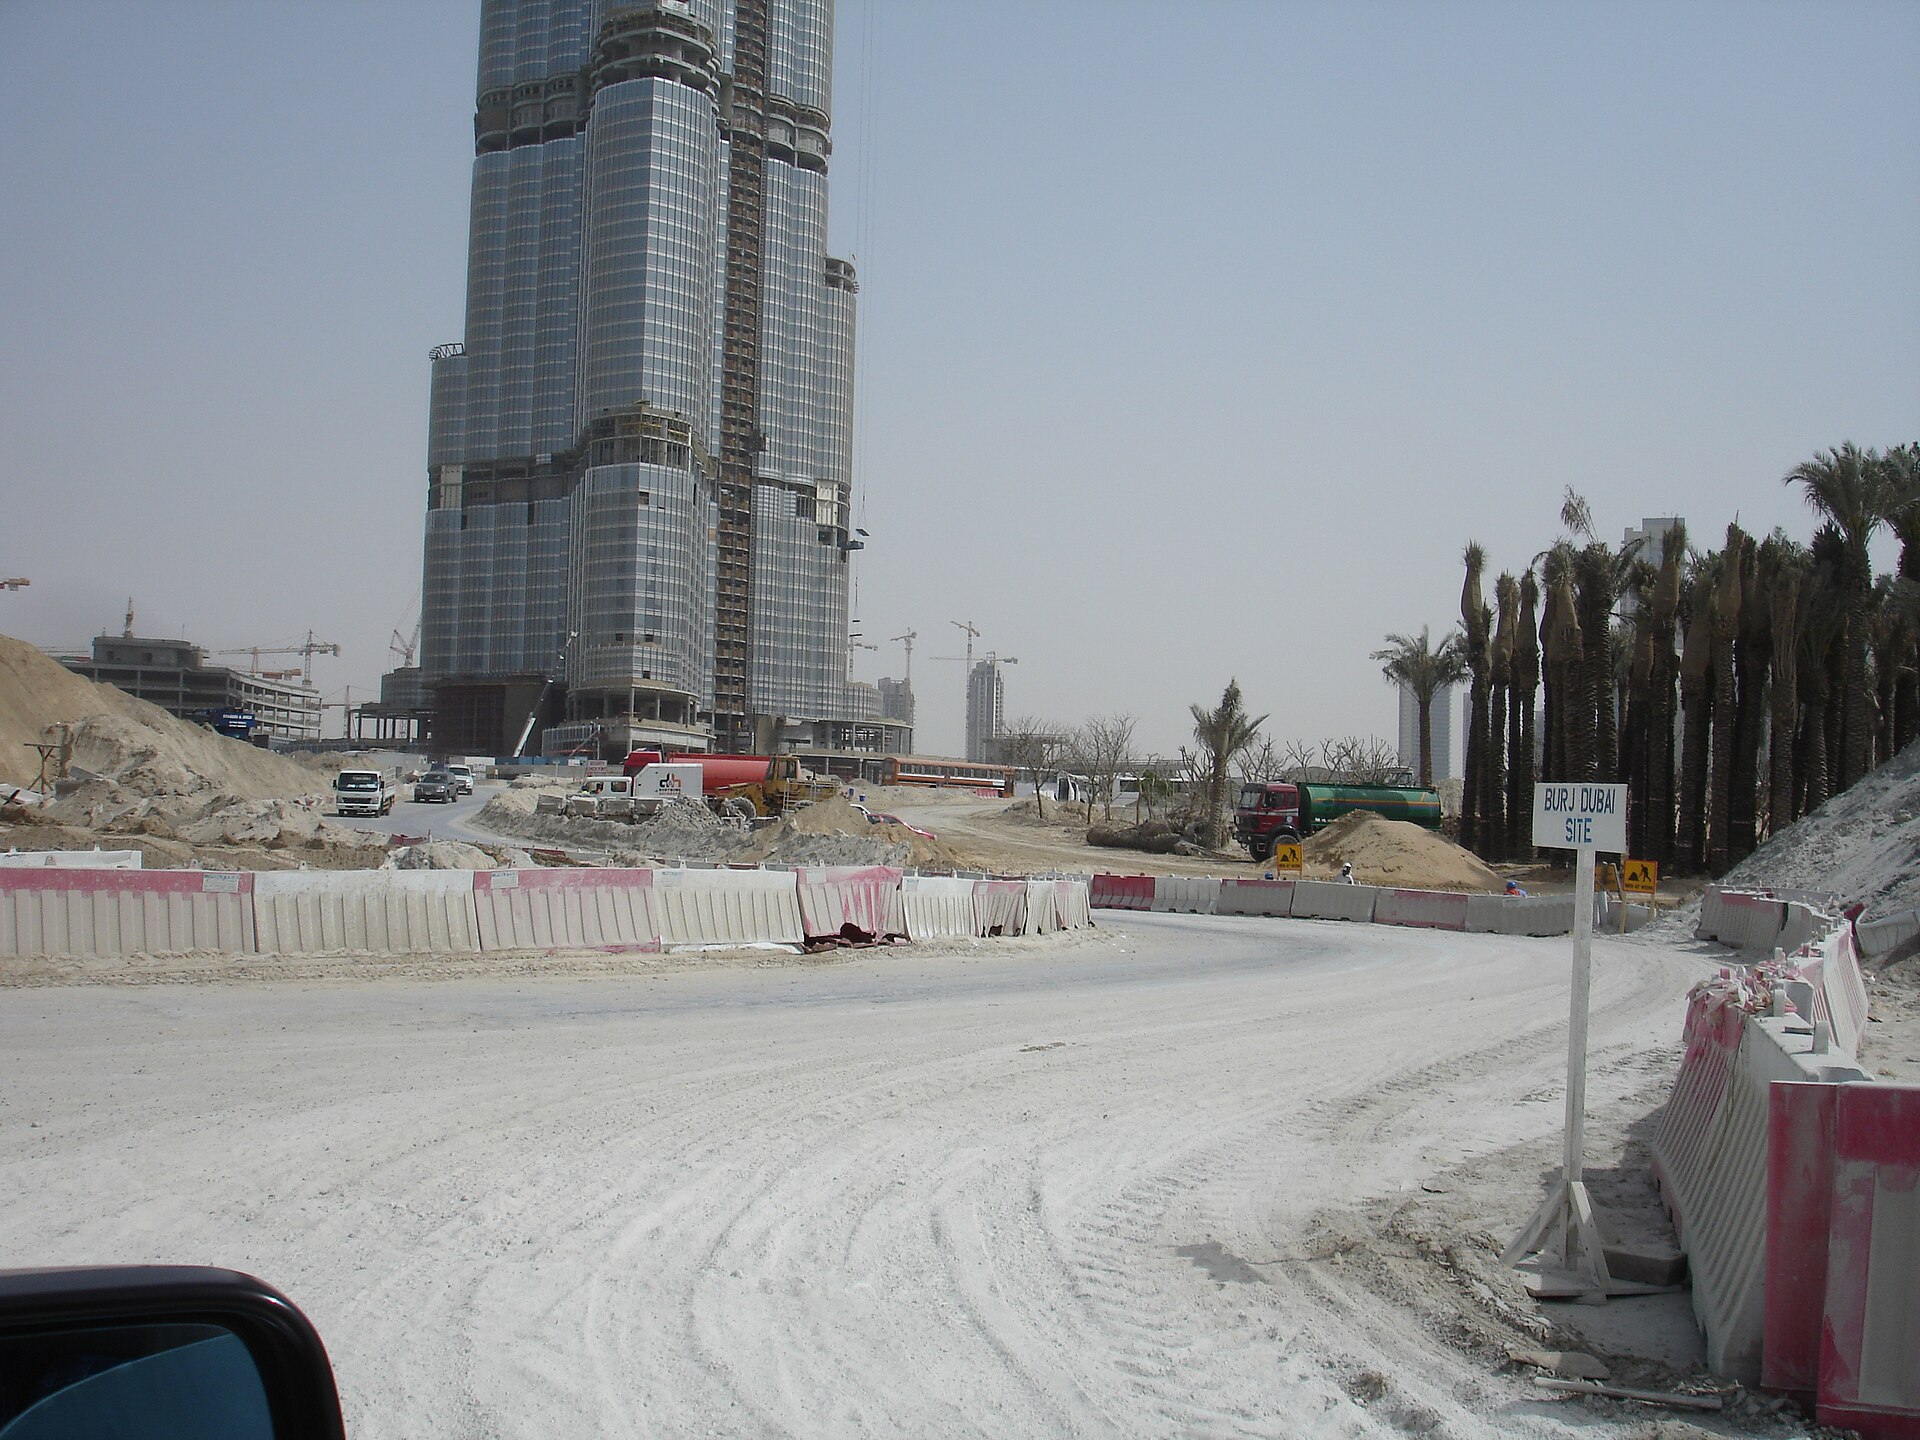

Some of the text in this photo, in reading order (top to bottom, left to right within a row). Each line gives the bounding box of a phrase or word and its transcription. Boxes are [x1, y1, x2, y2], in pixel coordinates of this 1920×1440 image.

[1544, 788, 1616, 814] BURJ DUBAI
[1565, 818, 1592, 843] SITE
